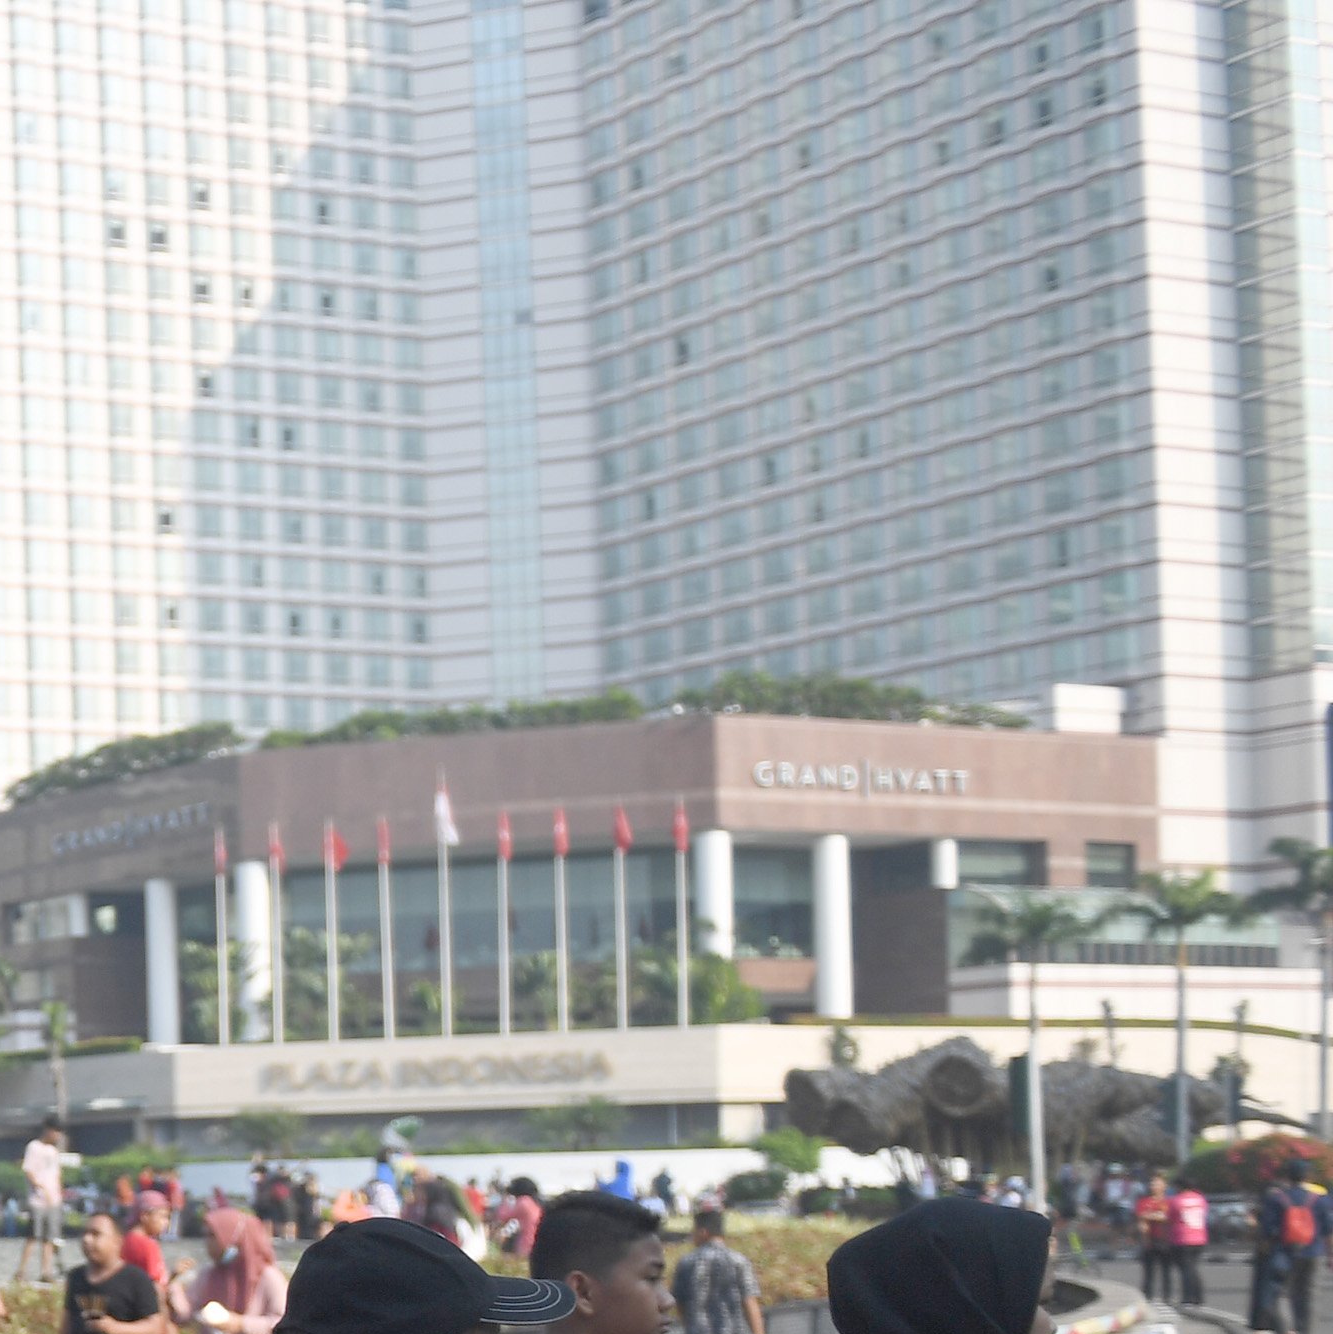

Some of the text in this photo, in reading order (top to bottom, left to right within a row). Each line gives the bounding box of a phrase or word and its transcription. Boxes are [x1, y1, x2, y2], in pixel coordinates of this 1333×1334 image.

[751, 760, 970, 796] GRAND HYATT
[258, 1051, 612, 1093] PLAZA INDONESIA
